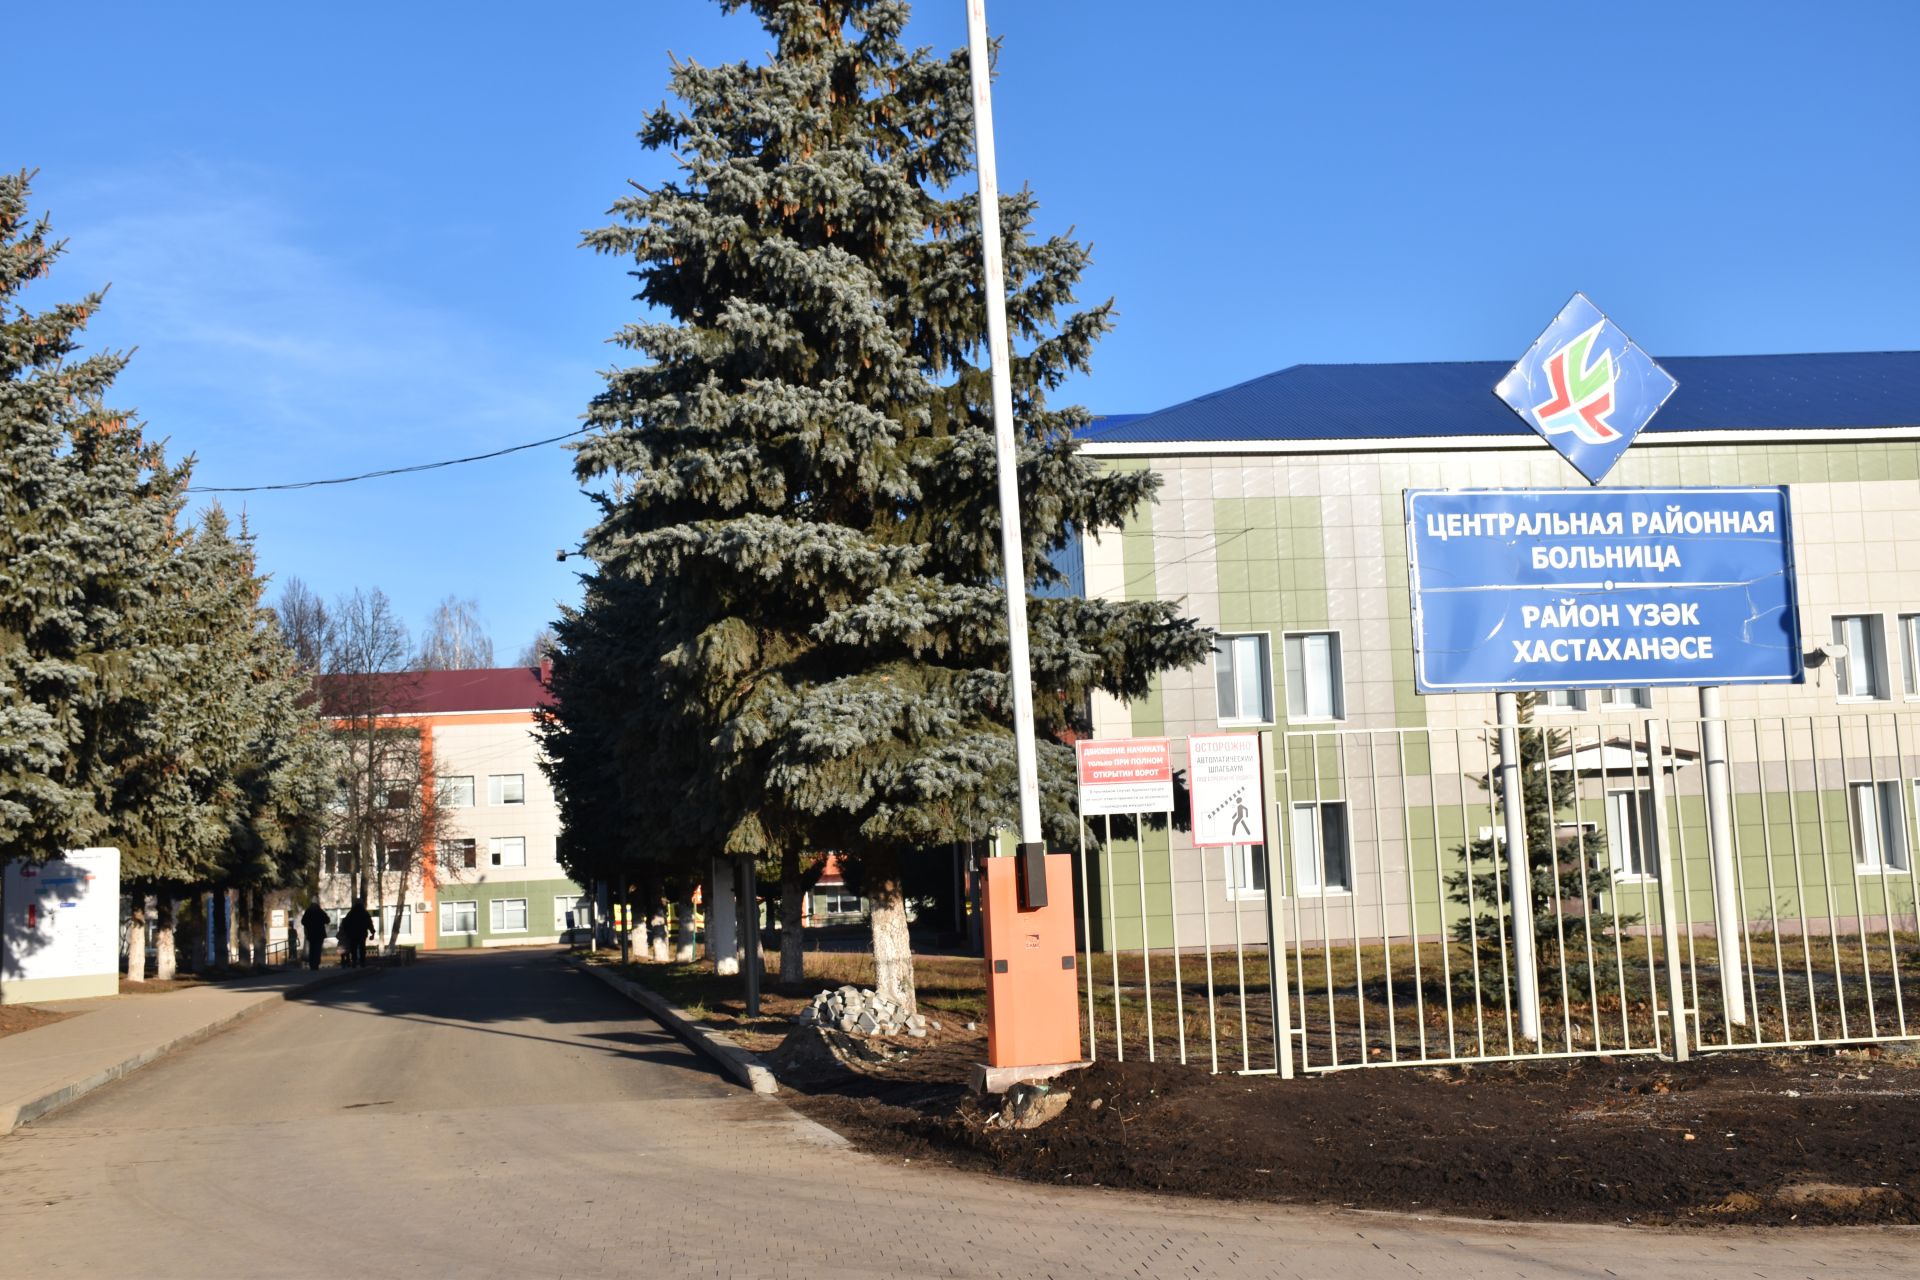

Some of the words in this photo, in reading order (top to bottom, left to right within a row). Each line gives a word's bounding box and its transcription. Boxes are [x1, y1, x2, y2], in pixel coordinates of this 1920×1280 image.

[1427, 512, 1623, 540] ЦЕНТРАЛЬНАЯ
[1632, 505, 1775, 538] РАЙОННАЯ
[1531, 545, 1681, 572] БОЛЬНИЦА
[1522, 598, 1619, 628] РАЙОН
[1623, 603, 1700, 627] ҮЗӘК
[1512, 637, 1713, 663] ХАСТАХАНӘСЕ
[1084, 746, 1125, 756] ДВИЖЕНИЕ
[1126, 745, 1165, 753] НАЧИНАТЬ
[1114, 758, 1129, 766] ПРИ
[1130, 757, 1164, 765] ПОЛНОМ
[1208, 765, 1243, 773] ШЛАГБАУМ
[1093, 770, 1133, 779] ОТКРЫТИИ
[1134, 768, 1159, 777] ВОРОТ
